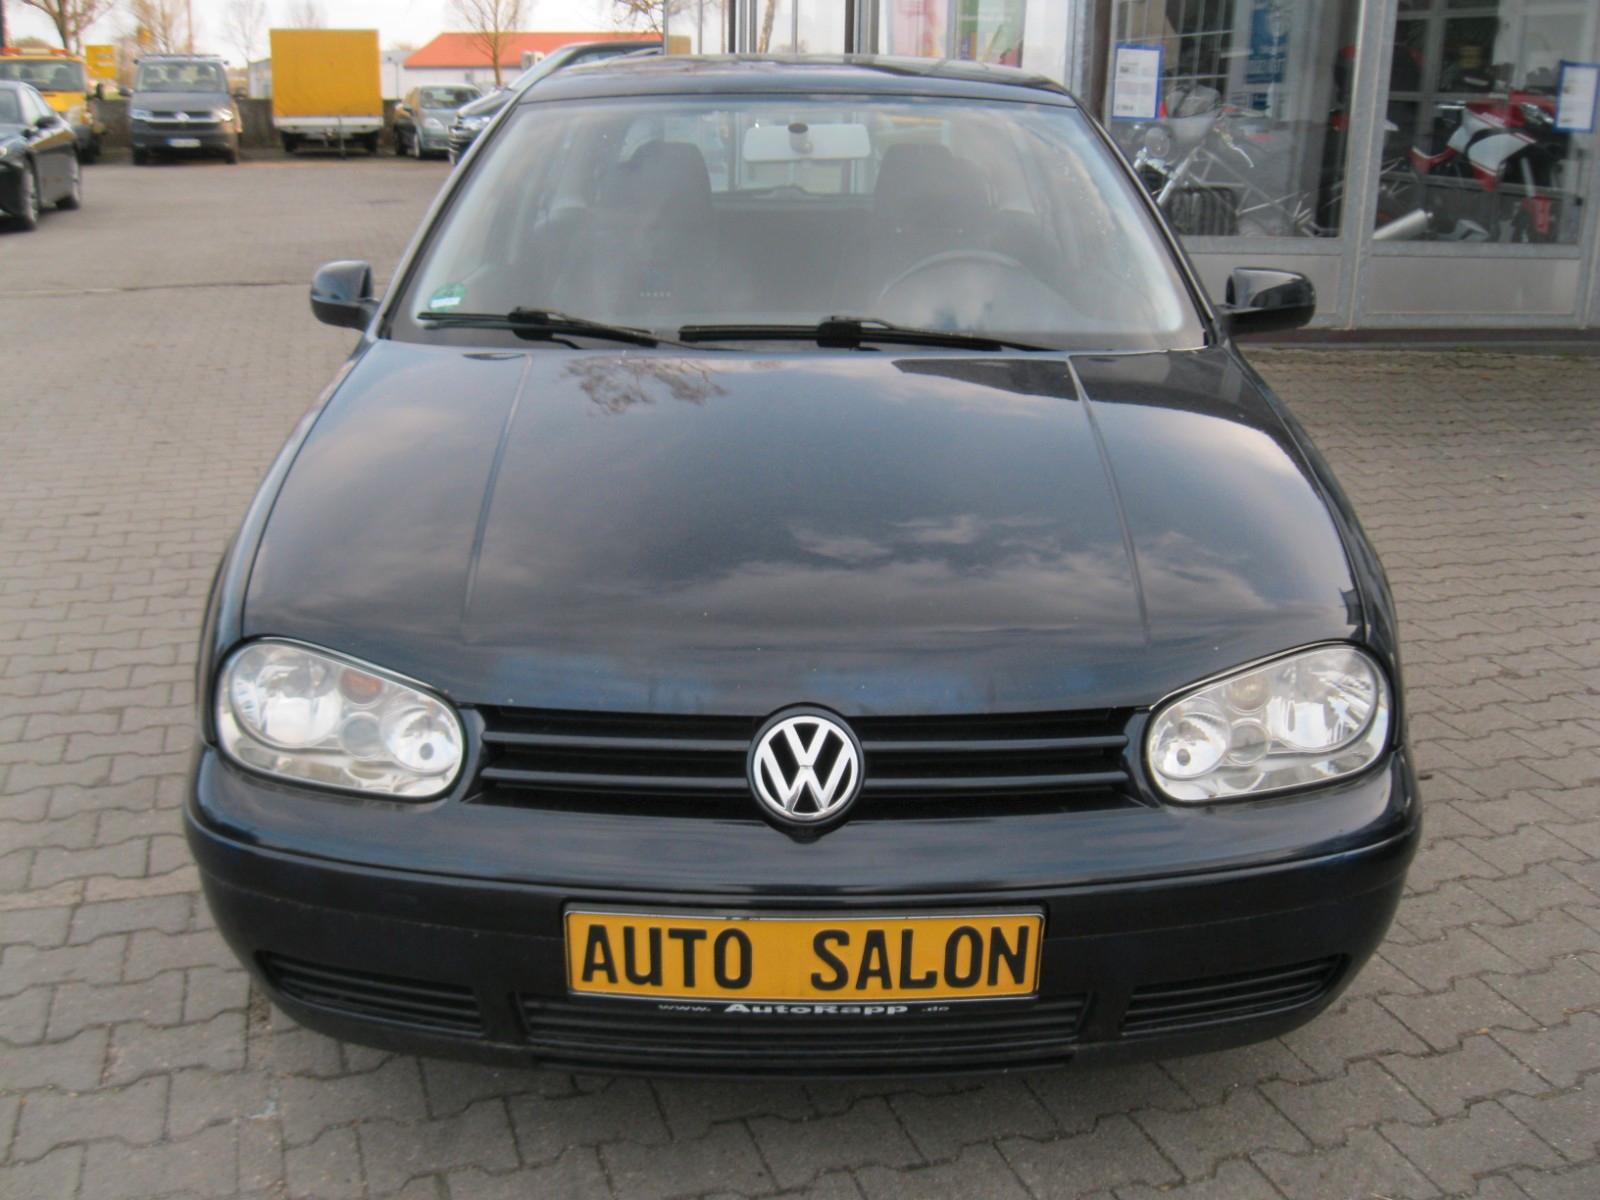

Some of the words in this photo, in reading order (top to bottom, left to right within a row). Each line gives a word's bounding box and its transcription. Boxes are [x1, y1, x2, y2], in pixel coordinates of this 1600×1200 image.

[755, 717, 857, 818] VW
[581, 924, 753, 990] AUTO
[810, 925, 1030, 991] SALON
[723, 1003, 909, 1016] AutoRapp
